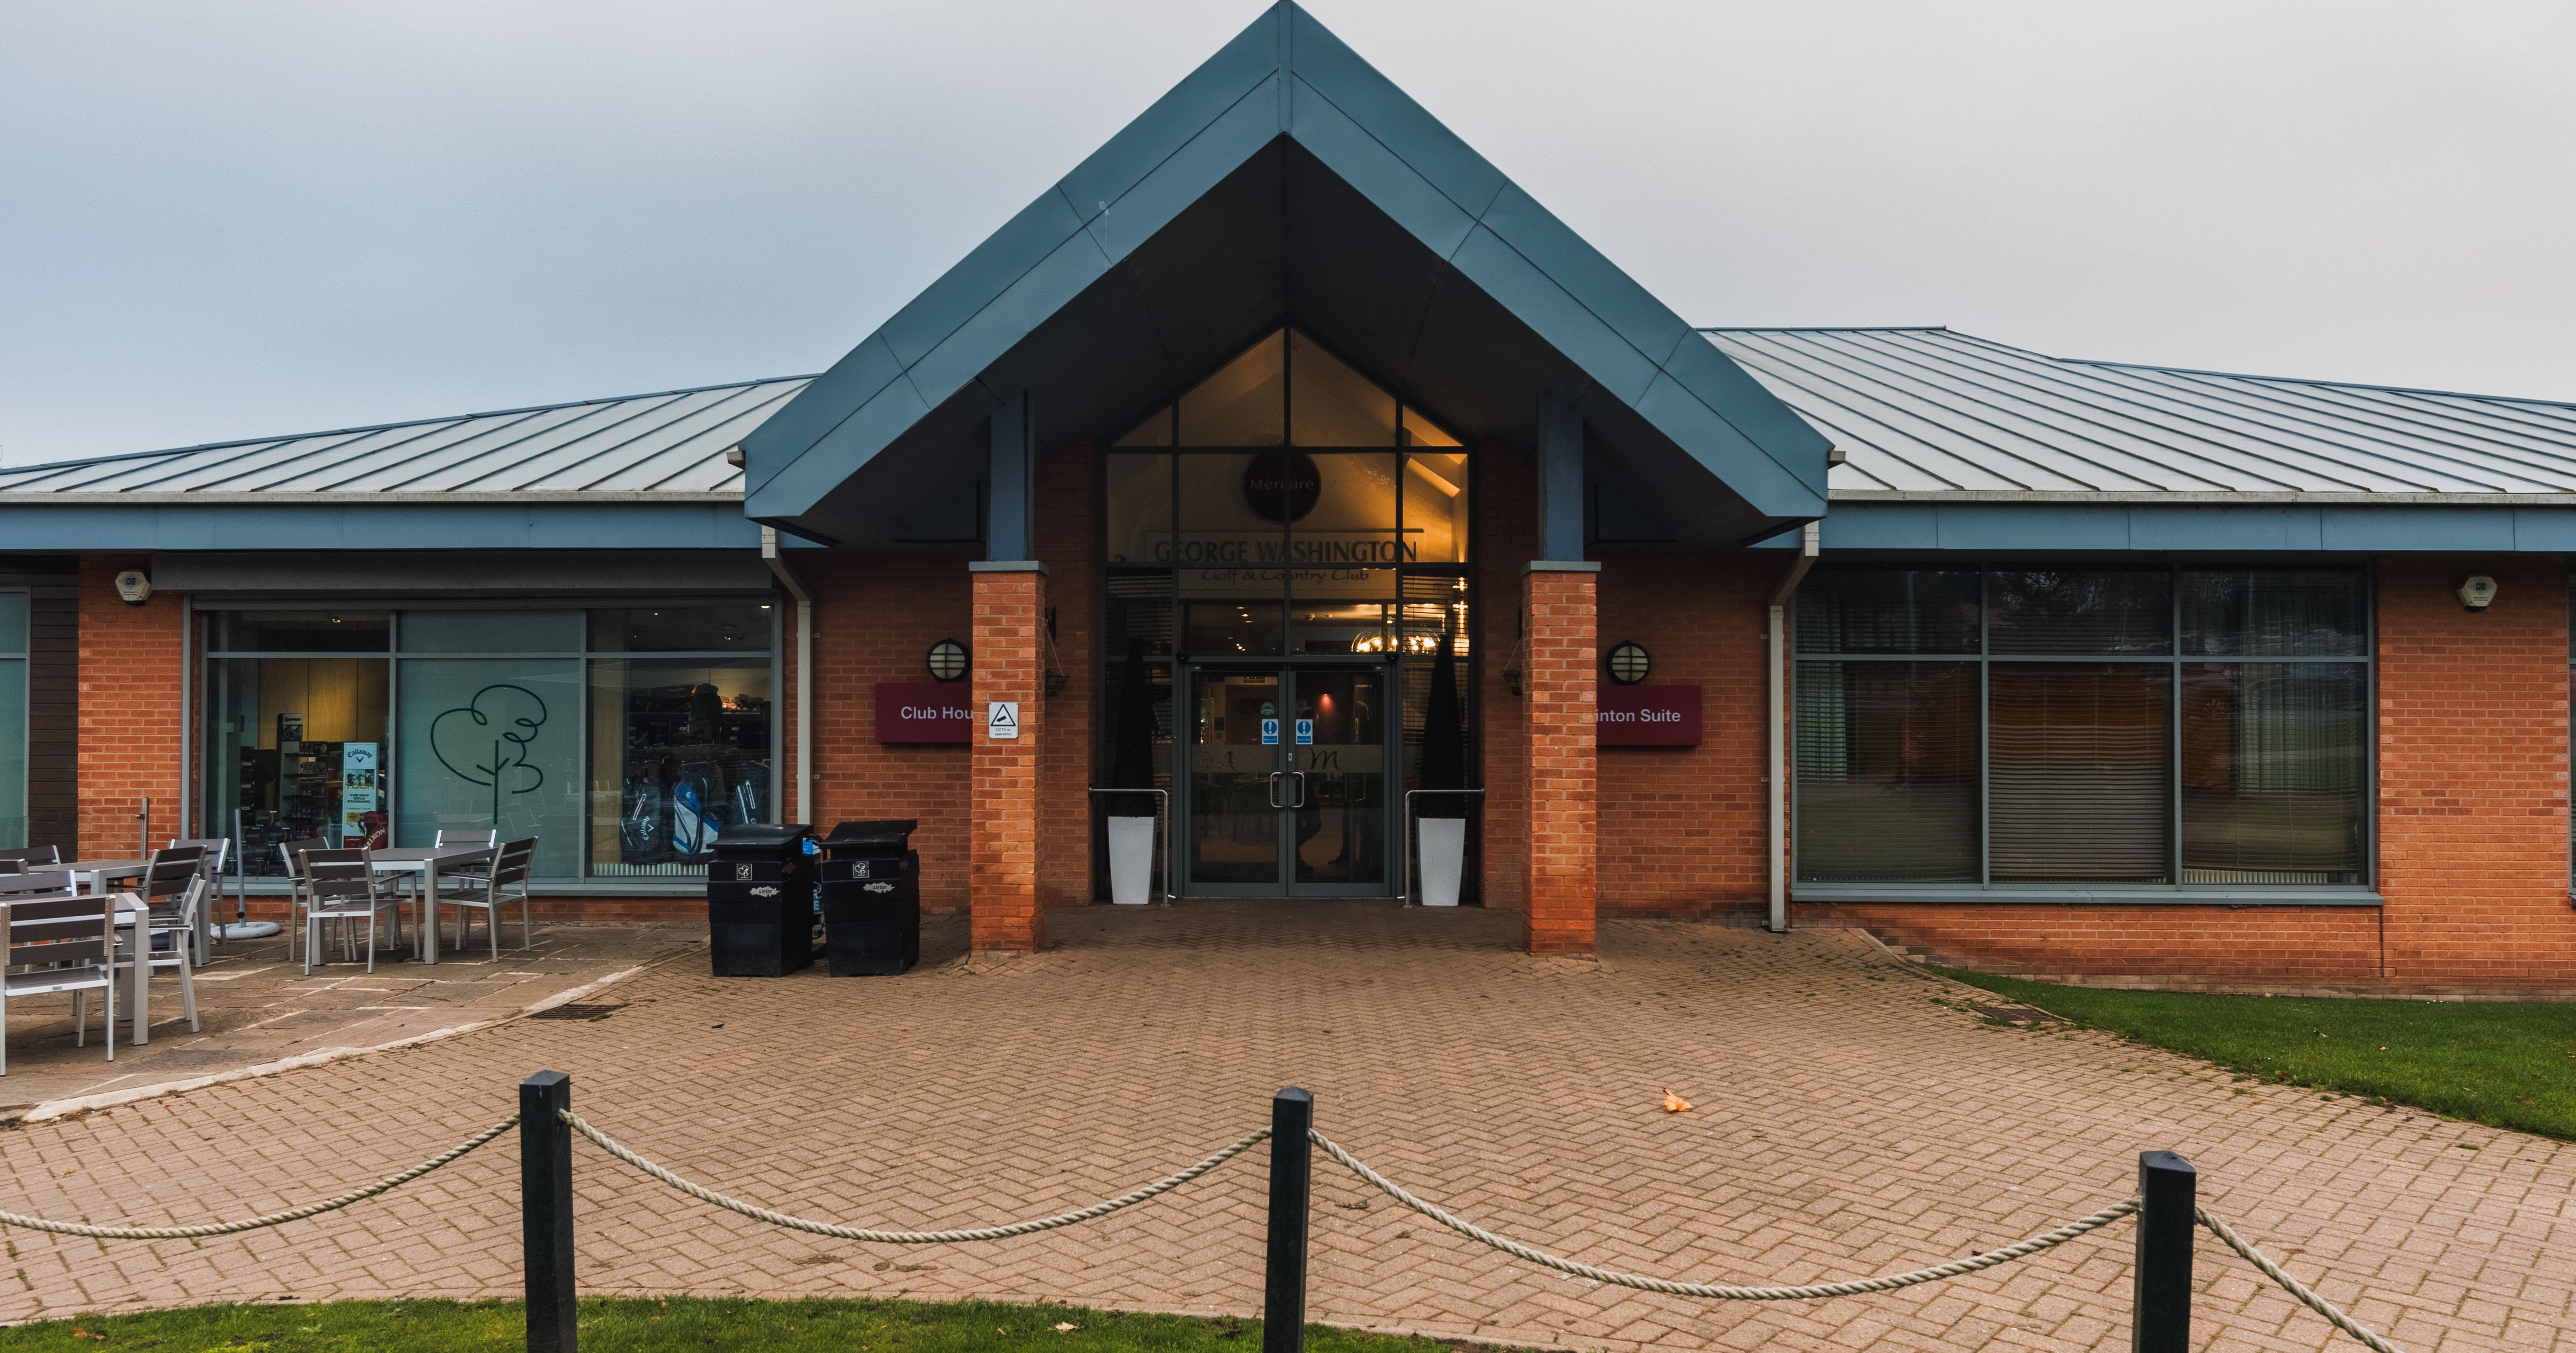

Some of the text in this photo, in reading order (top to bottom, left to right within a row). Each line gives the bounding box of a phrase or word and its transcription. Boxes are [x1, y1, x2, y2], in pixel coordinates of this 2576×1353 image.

[1250, 479, 1314, 490] Mercure
[1257, 540, 1417, 562] WASHINGTON
[1203, 568, 1237, 585] Golf
[1243, 568, 1256, 580] &
[1331, 568, 1369, 581] Club
[901, 706, 936, 719] Club
[1640, 709, 1681, 722] Suite
[348, 748, 373, 758] Callaway
[640, 815, 651, 841] Callaway
[364, 827, 386, 851] SRIXON
